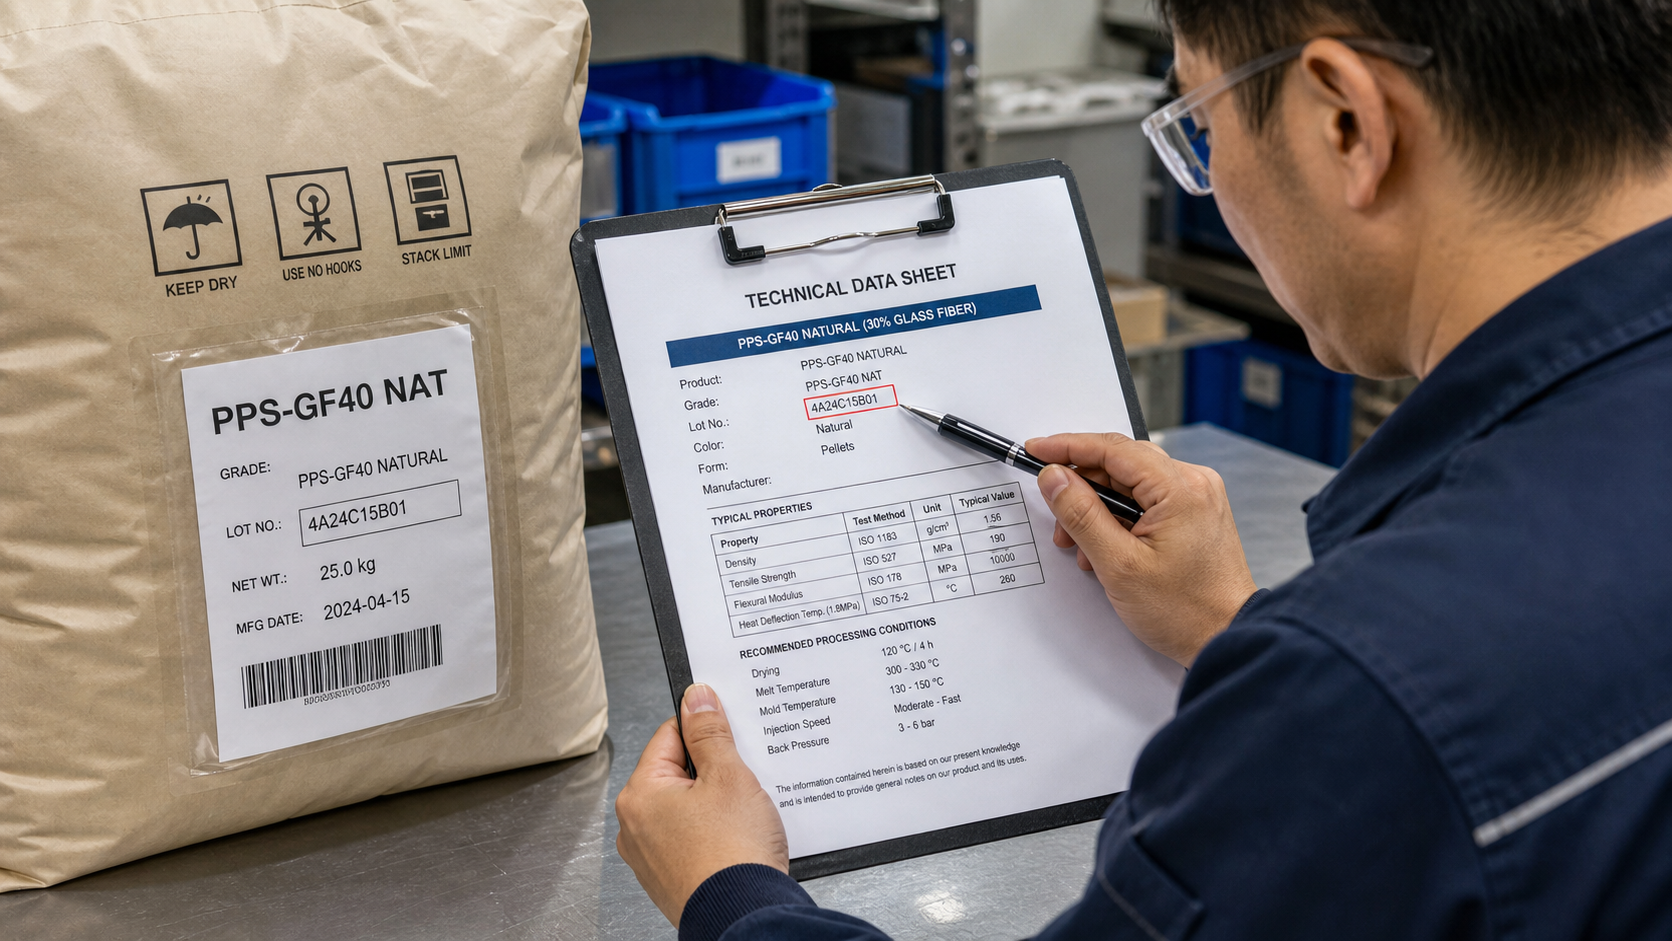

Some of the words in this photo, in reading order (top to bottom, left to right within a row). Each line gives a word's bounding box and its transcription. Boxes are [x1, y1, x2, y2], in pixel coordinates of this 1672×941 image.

[402, 248, 441, 265] STACK
[443, 244, 472, 260] LIMIT
[282, 266, 305, 281] USE
[307, 264, 323, 278] NO
[325, 259, 362, 275] HOOKS
[165, 280, 204, 297] KEEP
[208, 275, 237, 291] DRY
[744, 281, 848, 308] TECHNICAL
[851, 273, 898, 293] DATA
[901, 263, 956, 285] SHEET
[738, 330, 799, 349] PPS-GF40
[802, 321, 860, 340] NATURAL
[863, 316, 891, 332] (30%
[893, 309, 934, 325] GLASS
[937, 302, 976, 318] FIBER)
[800, 353, 854, 370] PPS-GF40
[856, 345, 907, 361] NATURAL
[679, 375, 722, 389] Product:
[805, 374, 859, 392] PPS-GF40
[861, 370, 882, 383] NAT
[212, 383, 373, 435] PPS-GF40
[383, 369, 447, 405] NAT
[684, 398, 719, 411] Grade:
[811, 393, 878, 413] 4A24C15B01
[688, 421, 706, 432] Lot
[708, 419, 729, 429] No.:
[816, 419, 853, 434] Natural
[693, 441, 724, 453] Color:
[821, 442, 855, 455] Pellets
[220, 461, 271, 480] GRADE:
[298, 461, 373, 489] PPS-GF40
[377, 448, 448, 474] NATURAL
[698, 462, 728, 474] Form:
[702, 477, 771, 495] Manufacturer:
[922, 503, 942, 514] Unit
[959, 494, 990, 508] Typical
[990, 491, 1015, 501] Value
[308, 499, 406, 531] 4A24C15B01
[711, 512, 752, 526] TYPICAL
[753, 502, 812, 519] PROPERTIES
[852, 516, 872, 525] Test
[873, 509, 906, 522] Method
[226, 523, 251, 539] LOT
[255, 520, 281, 533] NO.:
[990, 533, 1006, 543] 190
[720, 536, 758, 548] Property
[858, 535, 875, 546] ISO
[933, 543, 953, 553] MPa
[725, 557, 756, 569] Density
[863, 555, 879, 566] ISO
[881, 552, 896, 563] 527
[990, 552, 1015, 564] 10000
[320, 560, 353, 581] 25.0
[357, 558, 376, 575] kg
[937, 563, 957, 574] MPa
[232, 577, 257, 593] NET
[260, 573, 287, 587] WT.:
[729, 577, 759, 588] Tensile
[760, 570, 797, 584] Strength
[867, 575, 884, 586] ISO
[886, 572, 902, 582] 178
[324, 588, 410, 620] 2024-04-15
[734, 596, 767, 609] Flexural
[768, 591, 803, 603] Modulus
[872, 596, 888, 606] ISO
[890, 592, 909, 603] 75-2
[236, 619, 264, 634] MFG
[267, 612, 303, 629] DATE:
[738, 619, 759, 629] Heat
[760, 613, 800, 626] Deflection
[801, 609, 825, 618] Temp.
[739, 639, 814, 659] RECOMMENDED
[815, 627, 877, 646] PROCESSING
[878, 617, 936, 635] CONDITIONS
[881, 645, 898, 656] 120
[751, 667, 780, 679] Drying
[885, 664, 902, 676] 300
[909, 660, 926, 672] 330
[755, 686, 775, 697] Melt
[776, 678, 830, 693] Temperature
[890, 683, 906, 694] 130
[914, 679, 931, 690] 150
[759, 704, 781, 716] Mold
[782, 697, 836, 711] Temperature
[894, 700, 934, 713] Moderate
[941, 694, 962, 705] Fast
[763, 723, 801, 737] Injection
[802, 715, 831, 730] Speed
[920, 719, 935, 728] bar
[767, 743, 790, 755] Back
[791, 737, 830, 750] Pressure
[775, 785, 791, 793] The
[792, 778, 834, 791] information
[835, 769, 871, 783] contained
[872, 766, 896, 776] herein
[904, 759, 927, 770] based
[928, 758, 939, 766] on
[939, 755, 952, 763] our
[953, 749, 981, 762] present
[779, 798, 794, 808] and
[846, 784, 874, 797] provide
[875, 778, 903, 792] general
[938, 770, 950, 778] our
[952, 763, 981, 777] product
[981, 760, 996, 770] and
